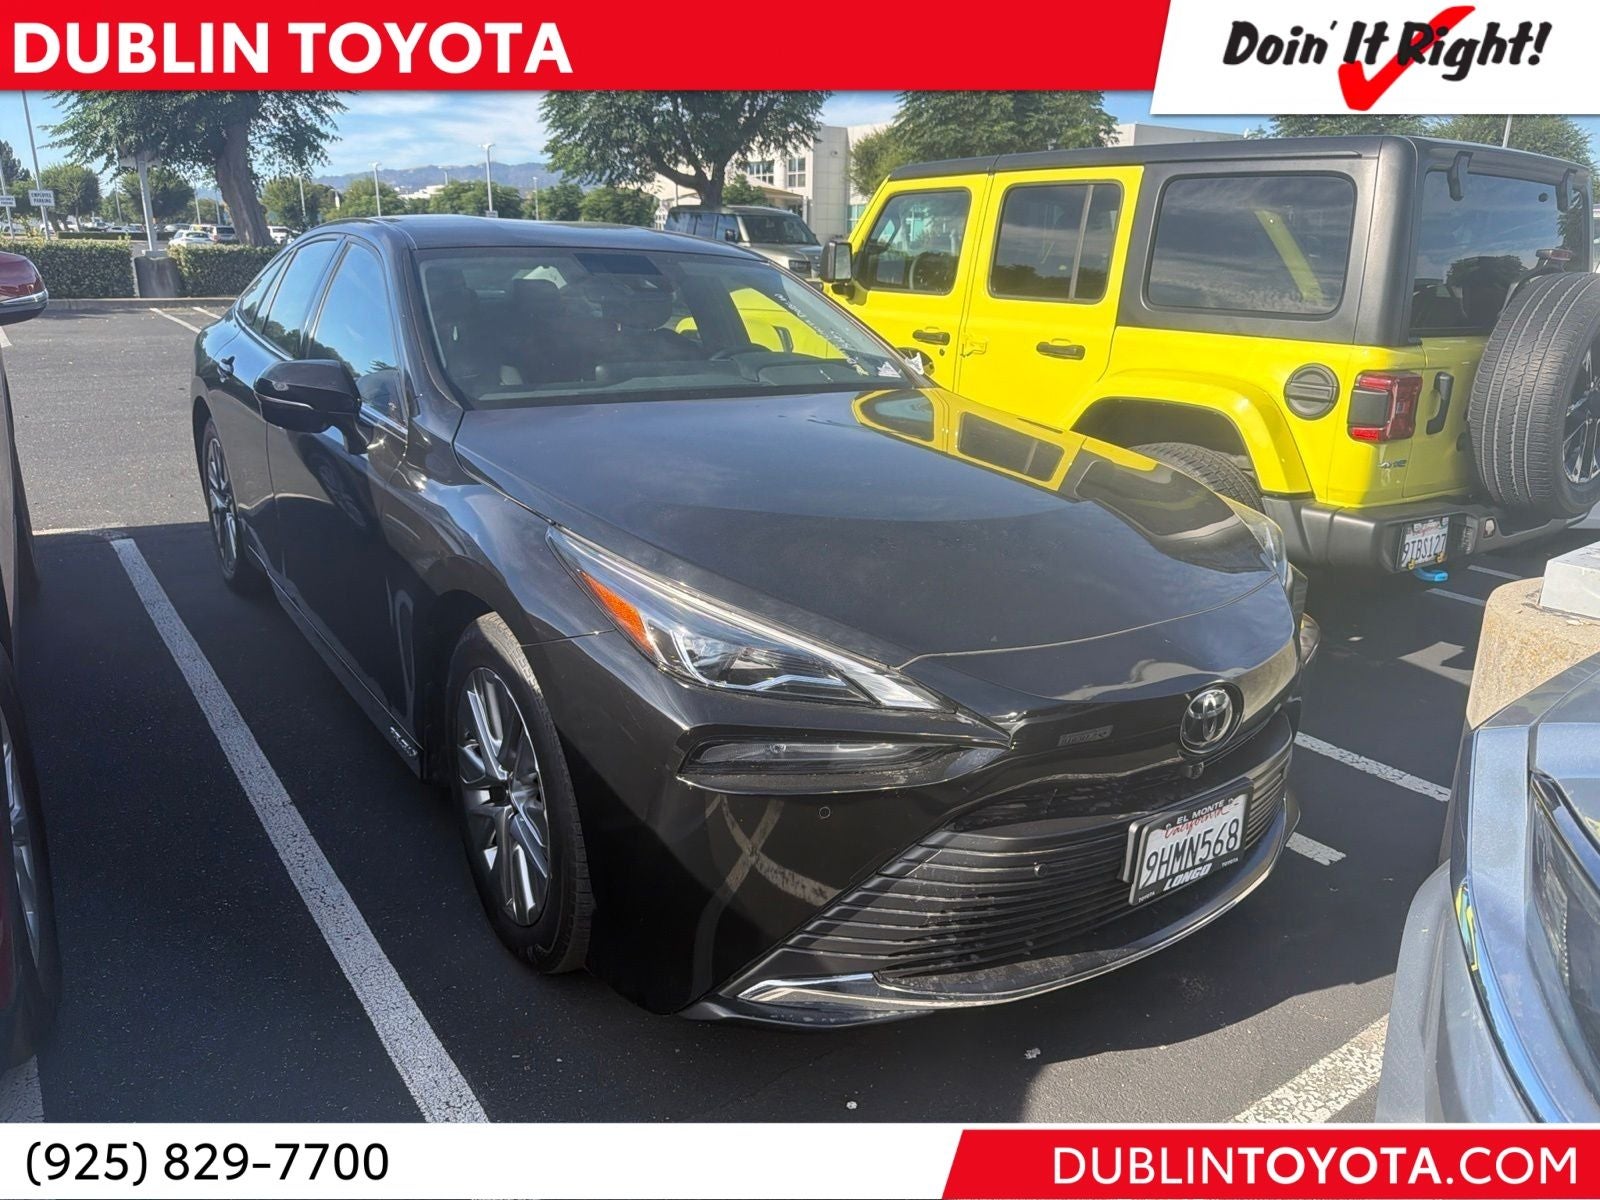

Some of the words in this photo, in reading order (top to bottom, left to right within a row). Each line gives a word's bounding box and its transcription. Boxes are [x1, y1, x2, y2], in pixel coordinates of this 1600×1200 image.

[1402, 534, 1447, 562] 9TBS127
[1177, 816, 1188, 825] EL
[1192, 800, 1225, 818] MONTE
[1141, 818, 1239, 888] 9HMN568
[1222, 858, 1238, 867] TOYOTA
[1163, 864, 1212, 891] LONGO
[1139, 892, 1154, 903] TOYOTA
